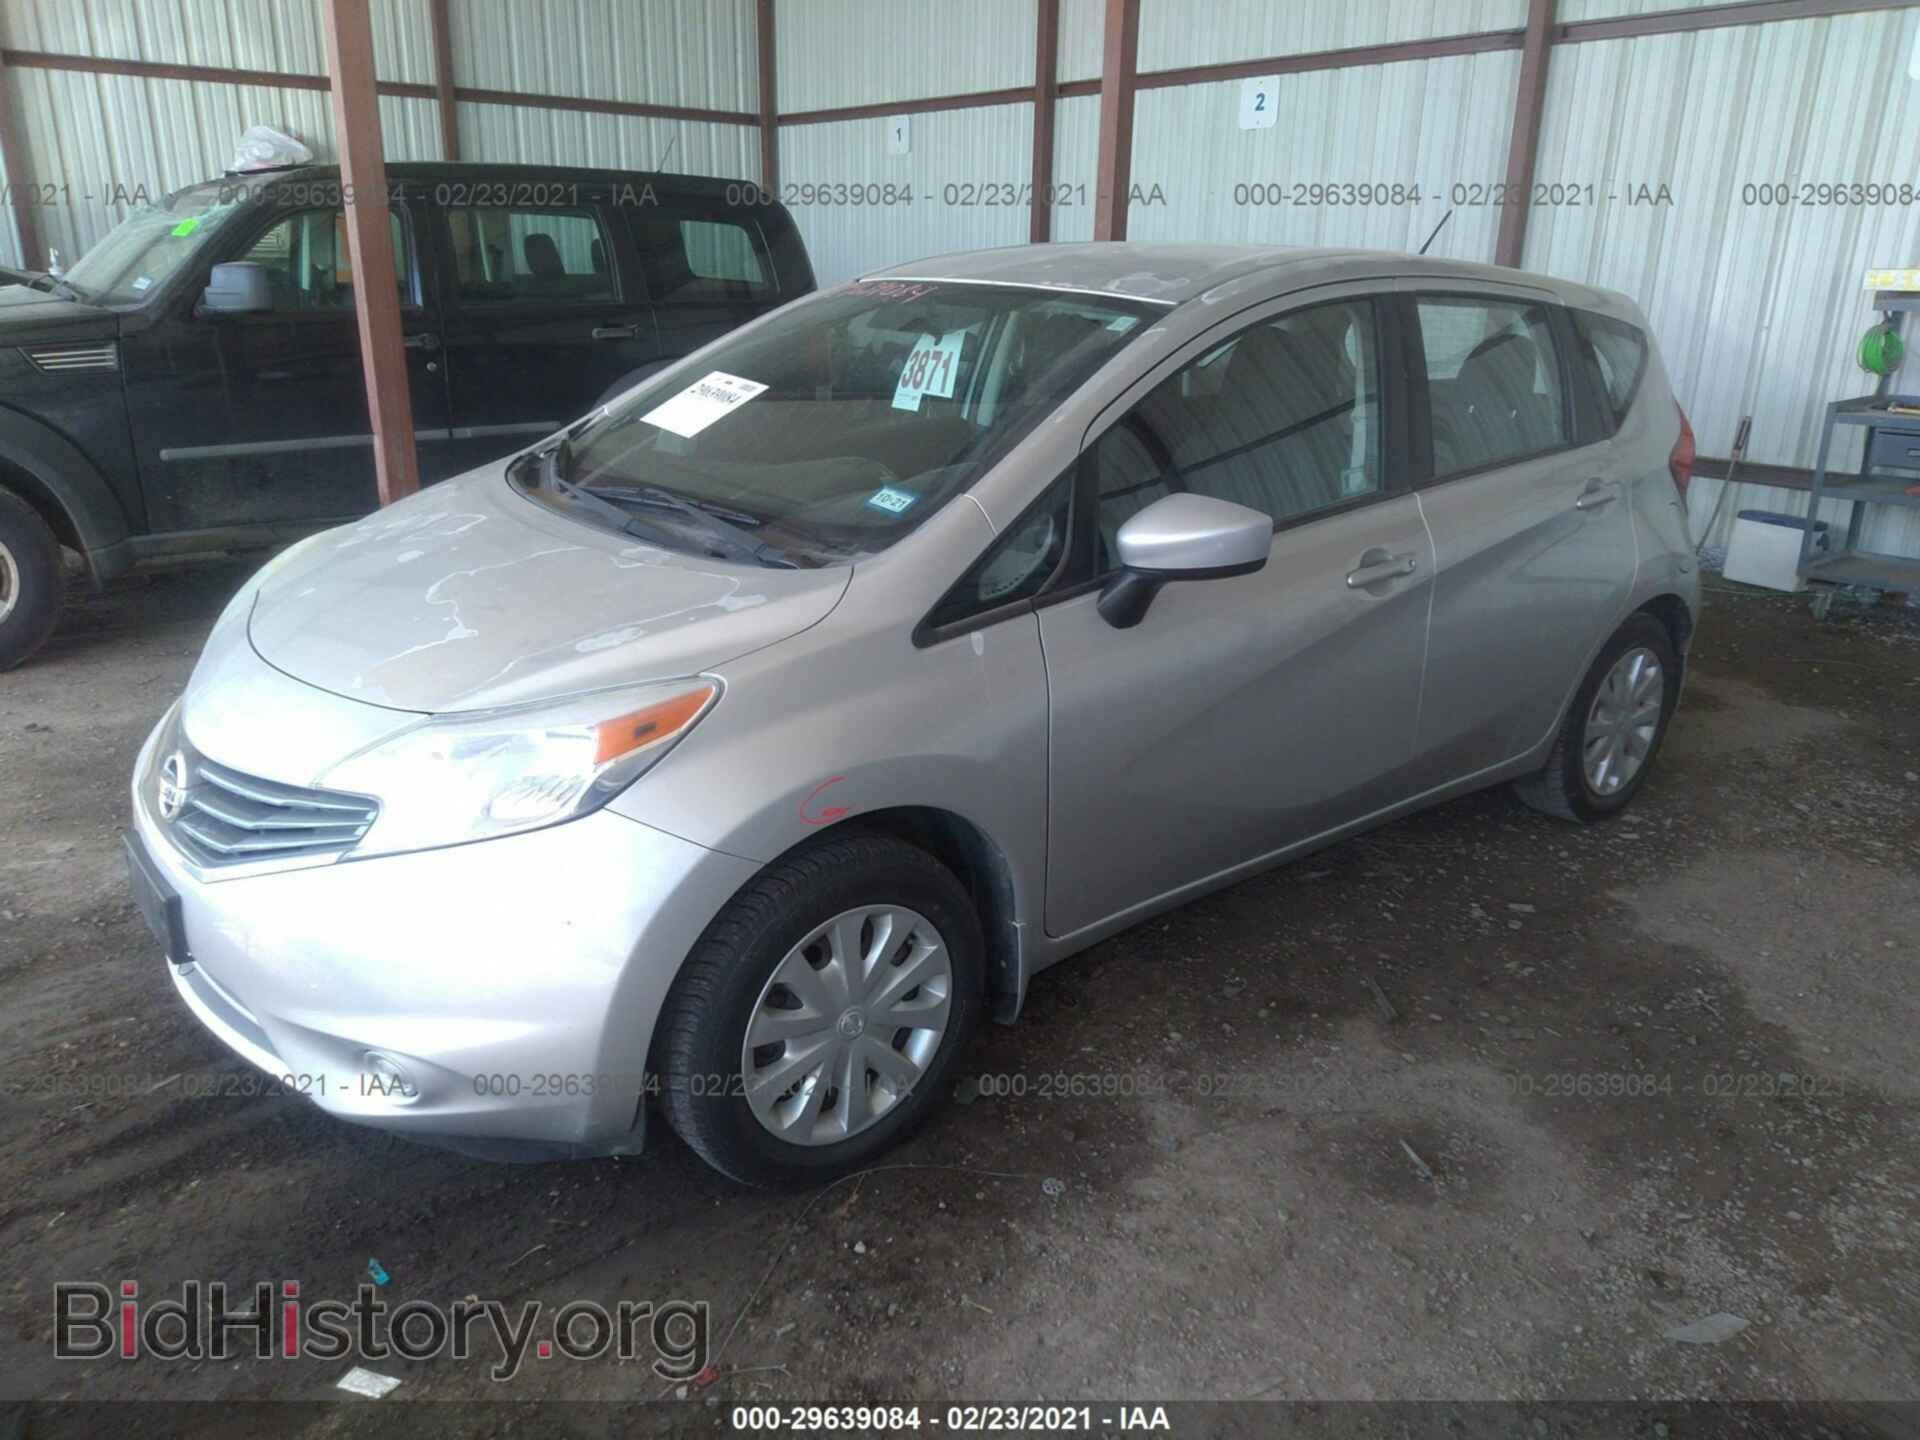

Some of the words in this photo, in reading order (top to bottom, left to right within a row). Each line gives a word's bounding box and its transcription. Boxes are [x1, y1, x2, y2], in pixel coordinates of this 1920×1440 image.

[1254, 93, 1266, 111] 2
[895, 128, 902, 142] 1
[901, 350, 953, 393] 3871
